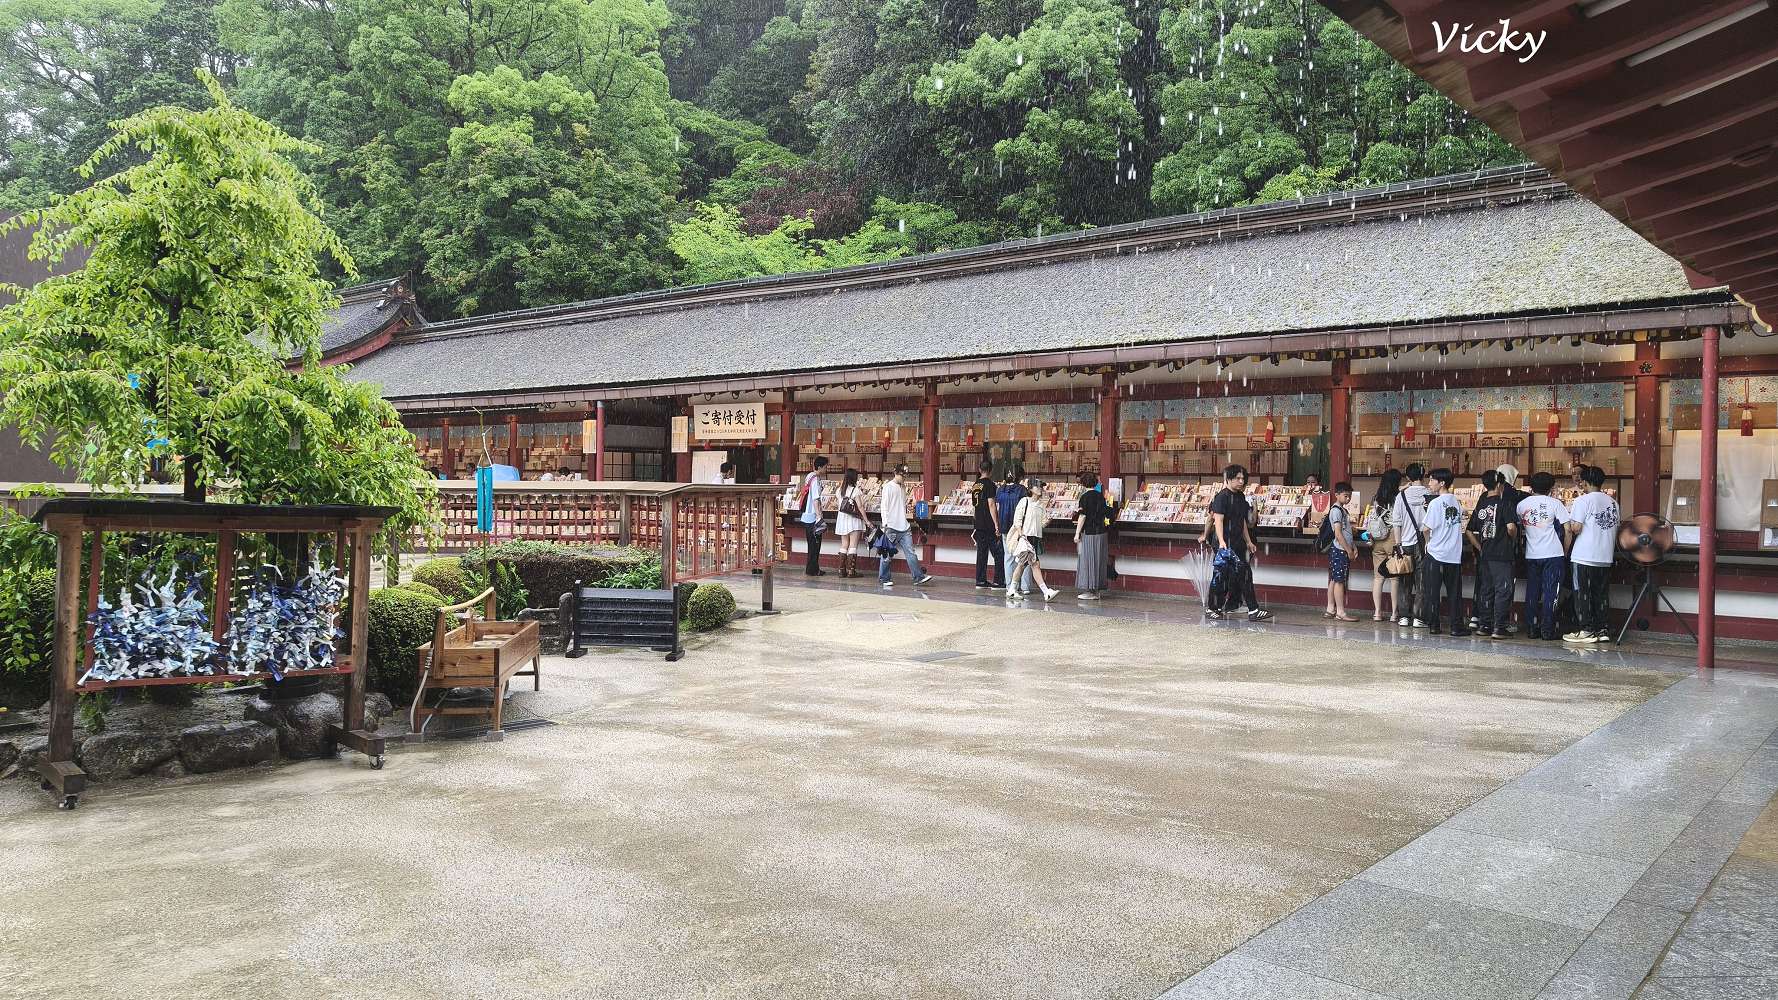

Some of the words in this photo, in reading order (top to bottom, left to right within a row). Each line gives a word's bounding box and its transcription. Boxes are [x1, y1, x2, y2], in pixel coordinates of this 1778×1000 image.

[701, 408, 757, 427] ご寄付受付
